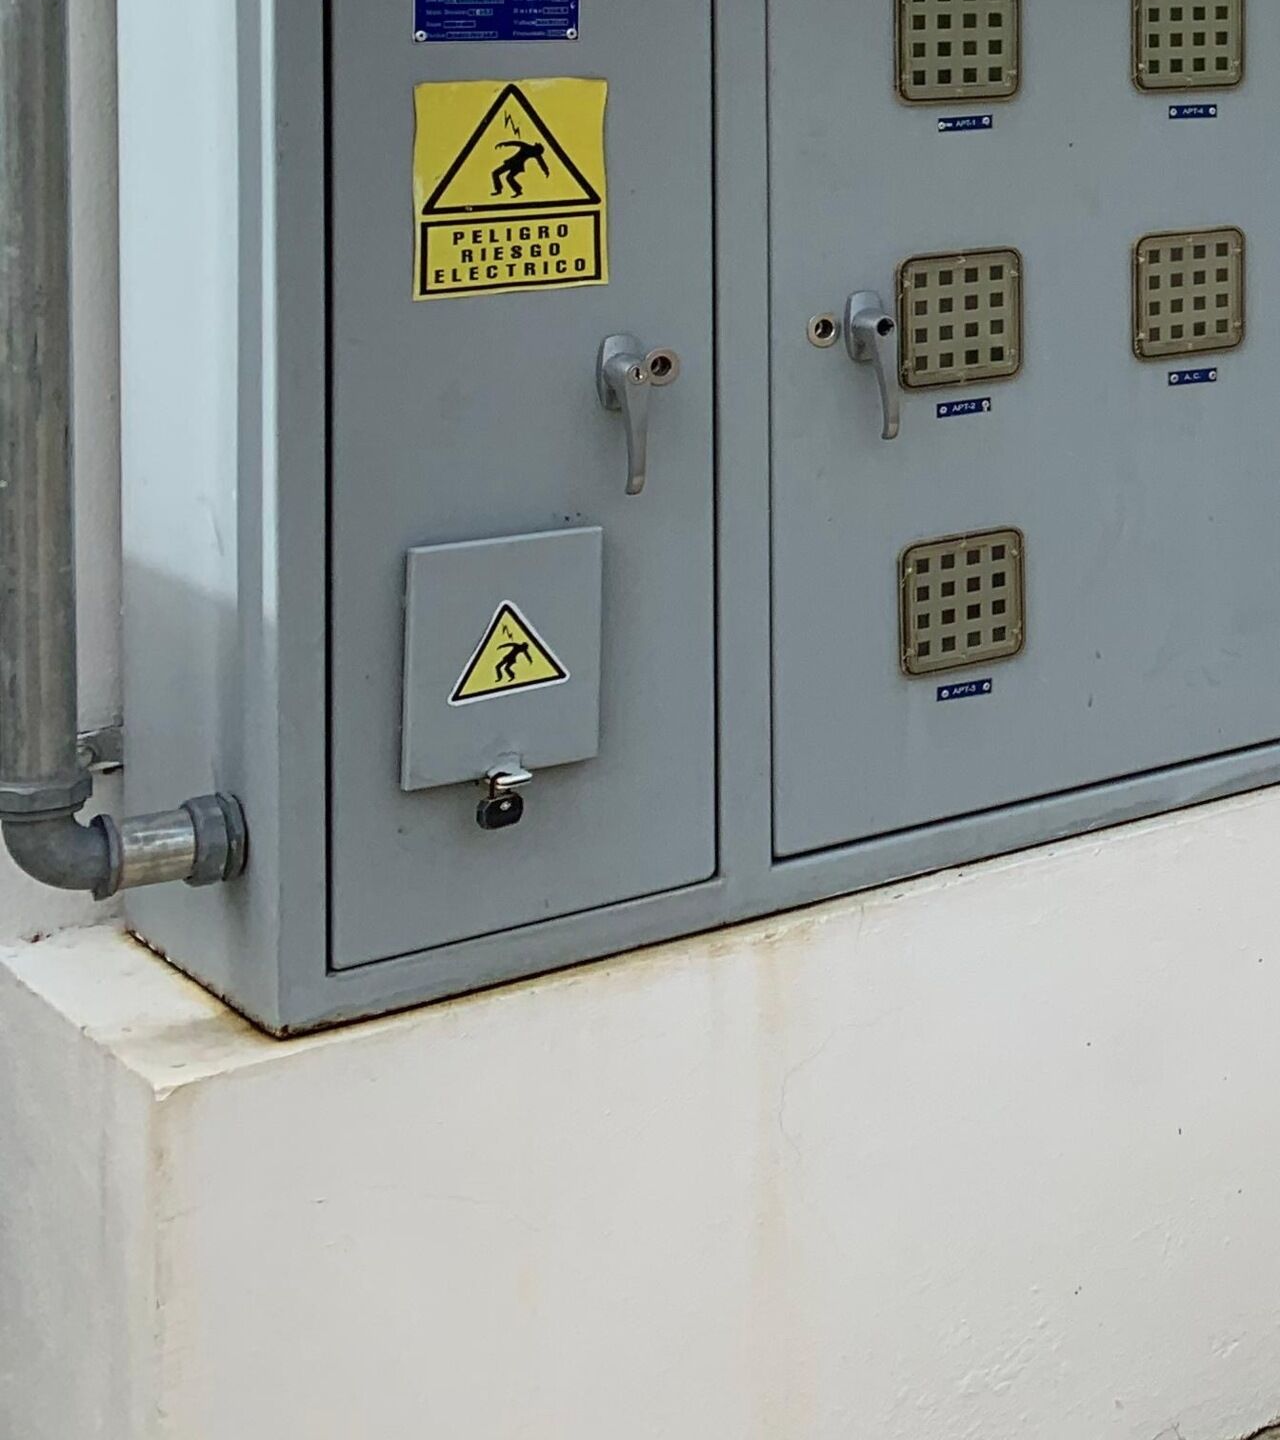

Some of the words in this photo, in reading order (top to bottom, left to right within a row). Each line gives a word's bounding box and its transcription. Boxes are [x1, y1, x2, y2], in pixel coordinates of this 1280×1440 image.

[955, 119, 976, 128] APT-1
[452, 224, 569, 246] PELIGRO
[461, 243, 561, 263] RIESGO
[434, 258, 586, 284] ELECTRICO
[952, 402, 976, 412] APT-2
